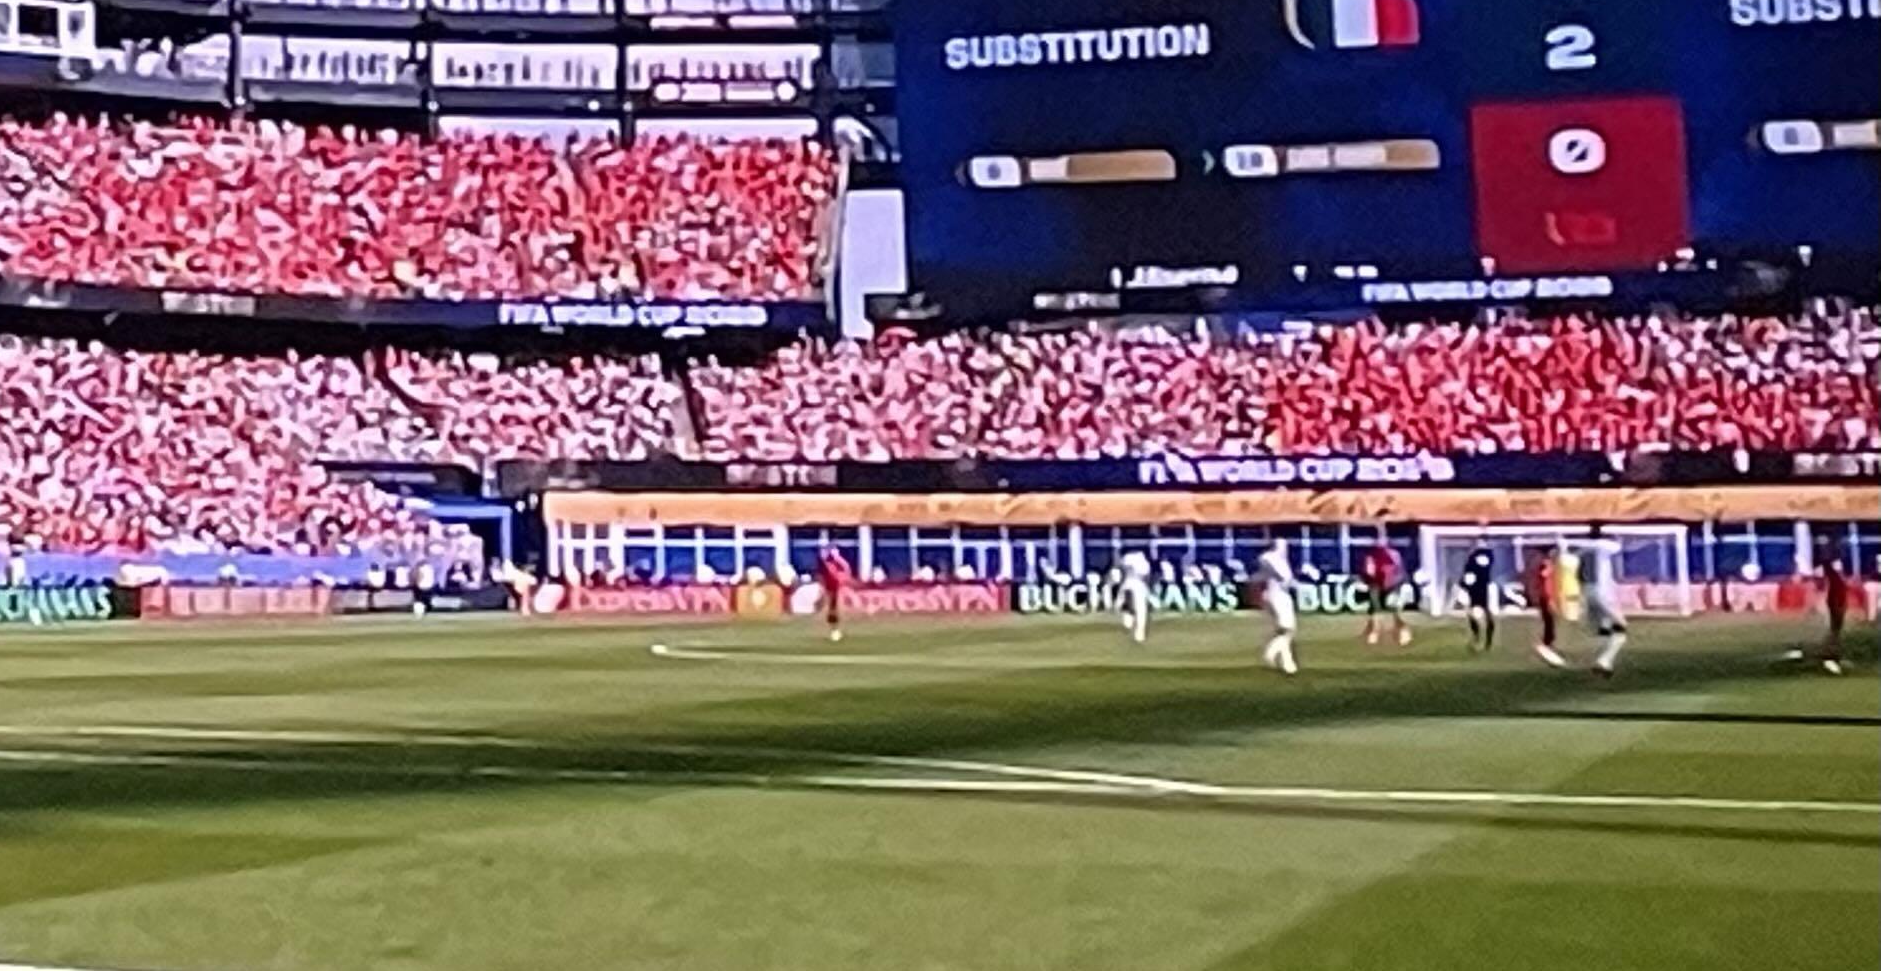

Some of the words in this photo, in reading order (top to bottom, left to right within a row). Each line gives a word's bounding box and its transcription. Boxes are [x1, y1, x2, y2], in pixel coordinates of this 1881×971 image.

[945, 23, 1210, 69] SUBSTITUTION
[1545, 24, 1597, 70] 2
[1549, 129, 1606, 173] 0
